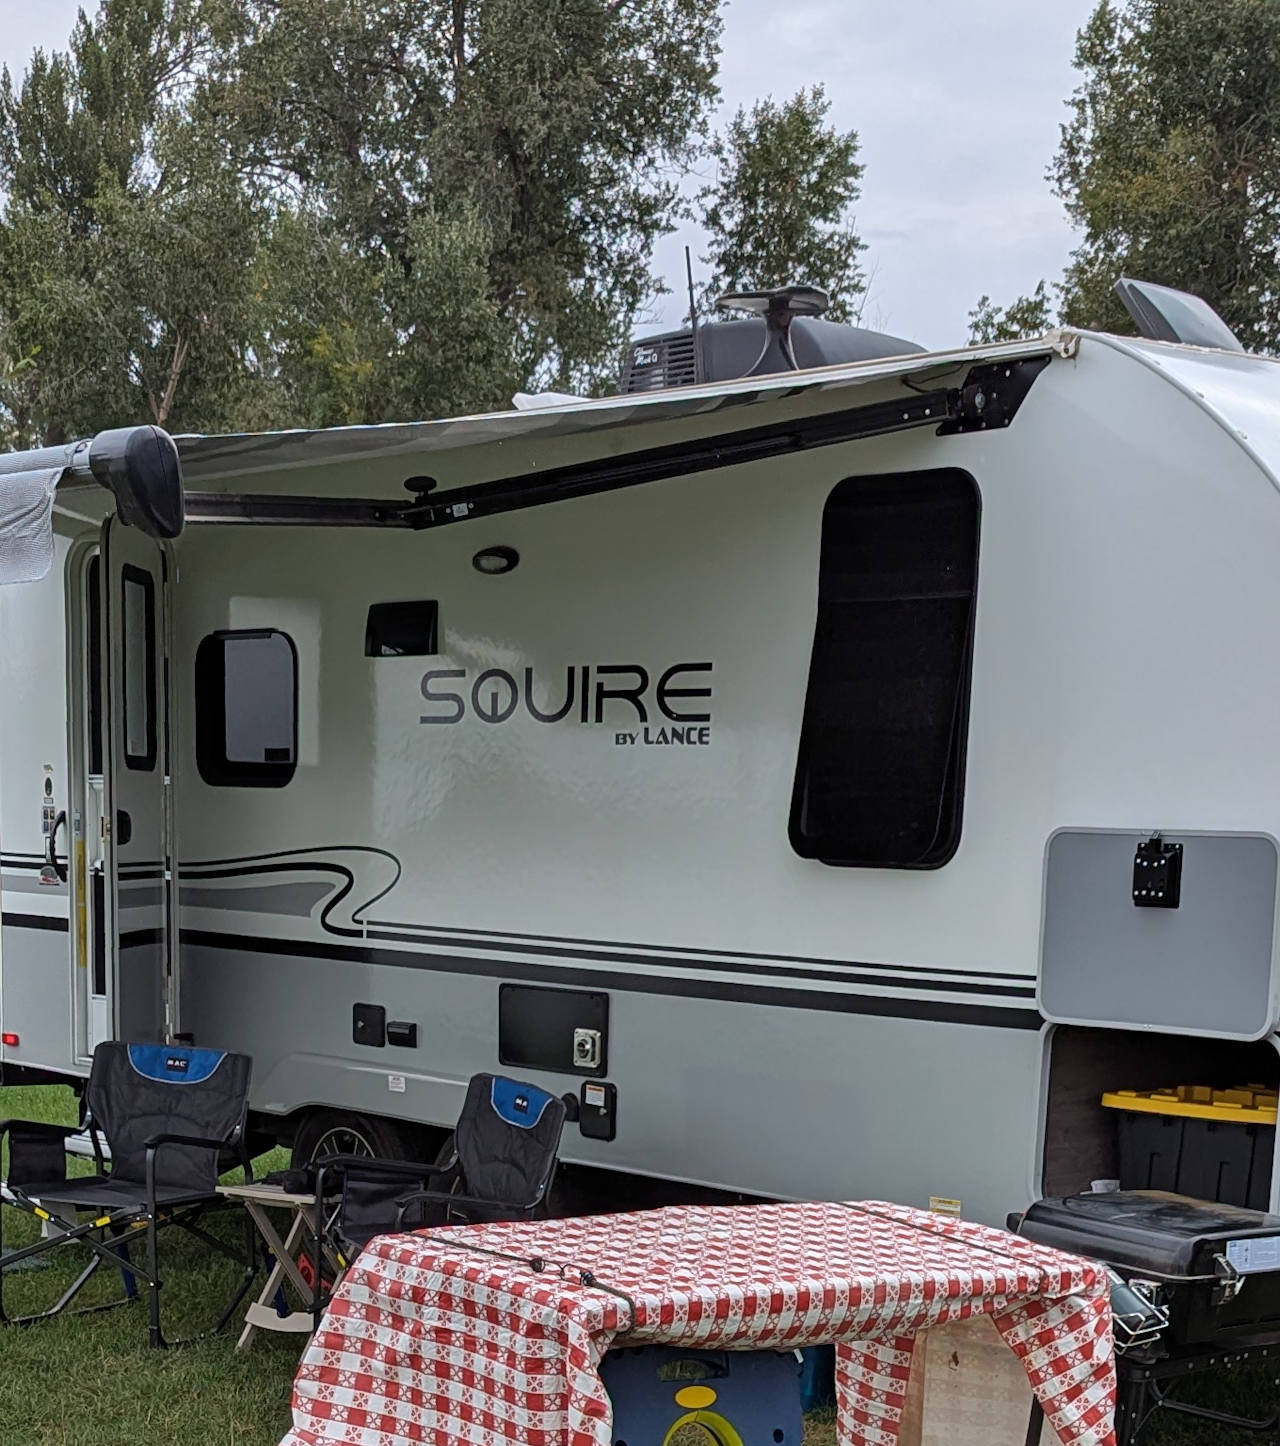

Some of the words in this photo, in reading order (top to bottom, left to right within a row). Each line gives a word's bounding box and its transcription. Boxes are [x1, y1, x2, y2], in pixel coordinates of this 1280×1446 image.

[420, 663, 713, 723] SQUIRE
[615, 732, 639, 745] BY
[643, 726, 711, 745] LANCE
